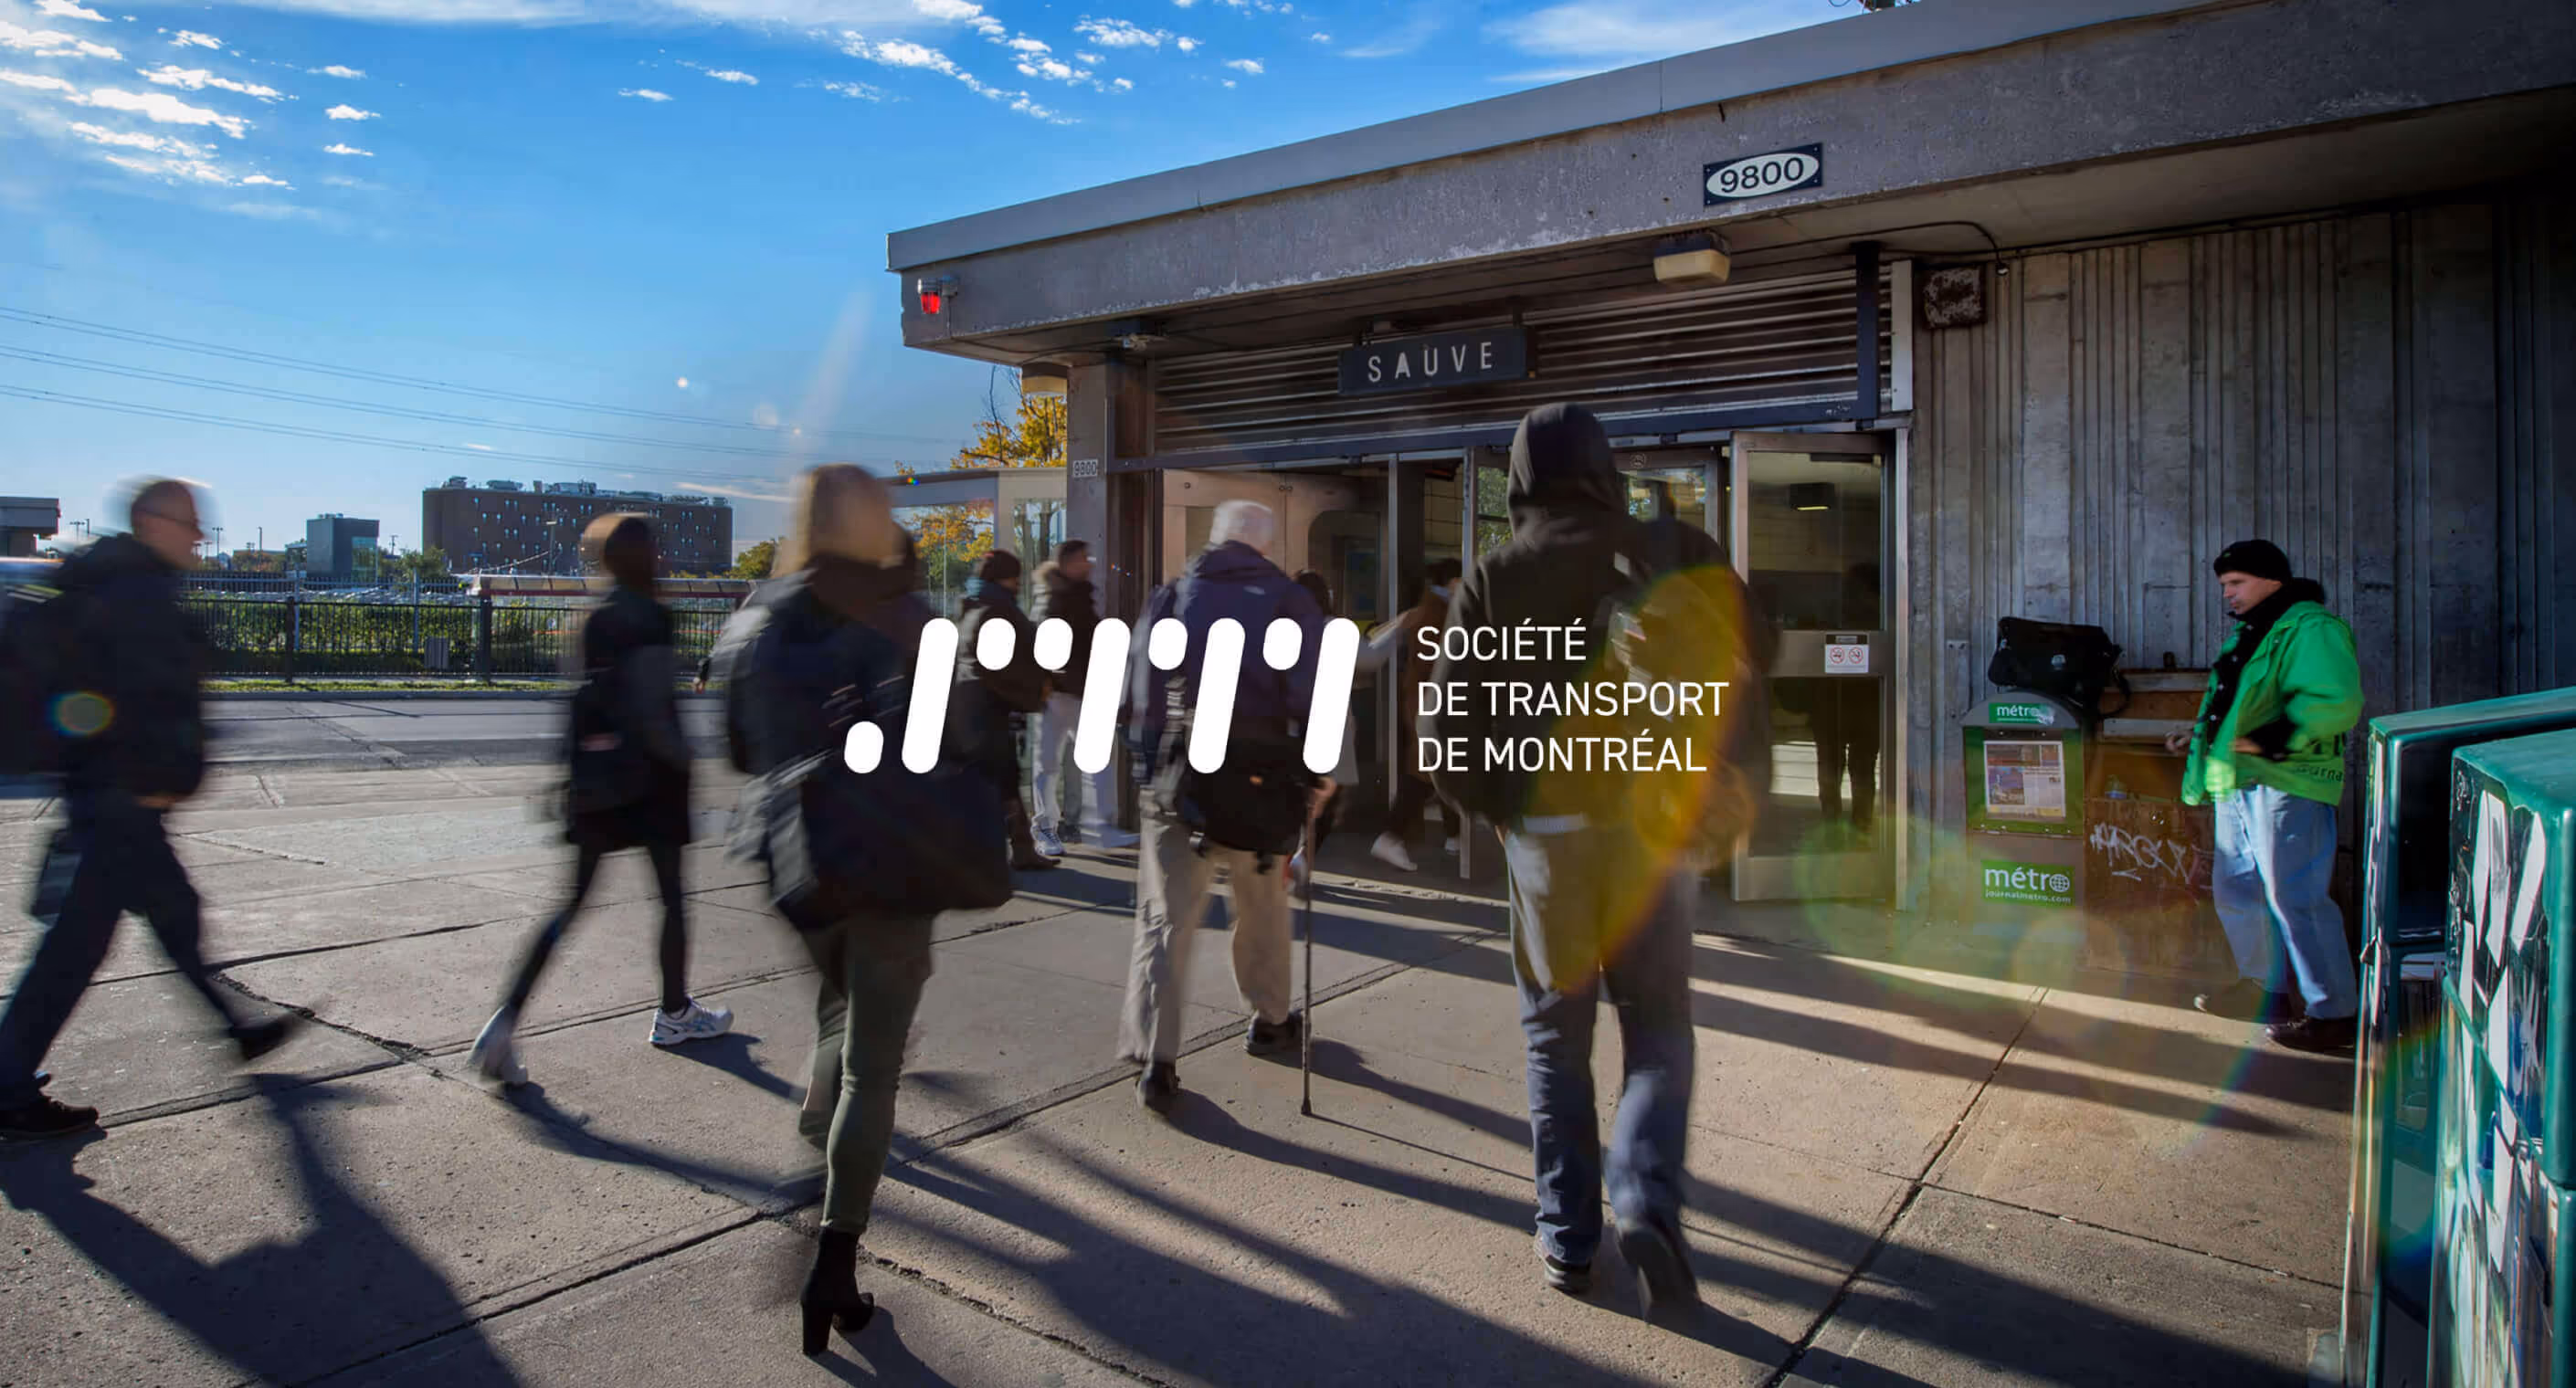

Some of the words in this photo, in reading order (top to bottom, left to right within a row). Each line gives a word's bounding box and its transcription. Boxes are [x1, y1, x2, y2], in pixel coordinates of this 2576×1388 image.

[1720, 156, 1804, 193] 9800
[1367, 342, 1492, 383] SAUVE
[1984, 866, 2071, 893] métro
